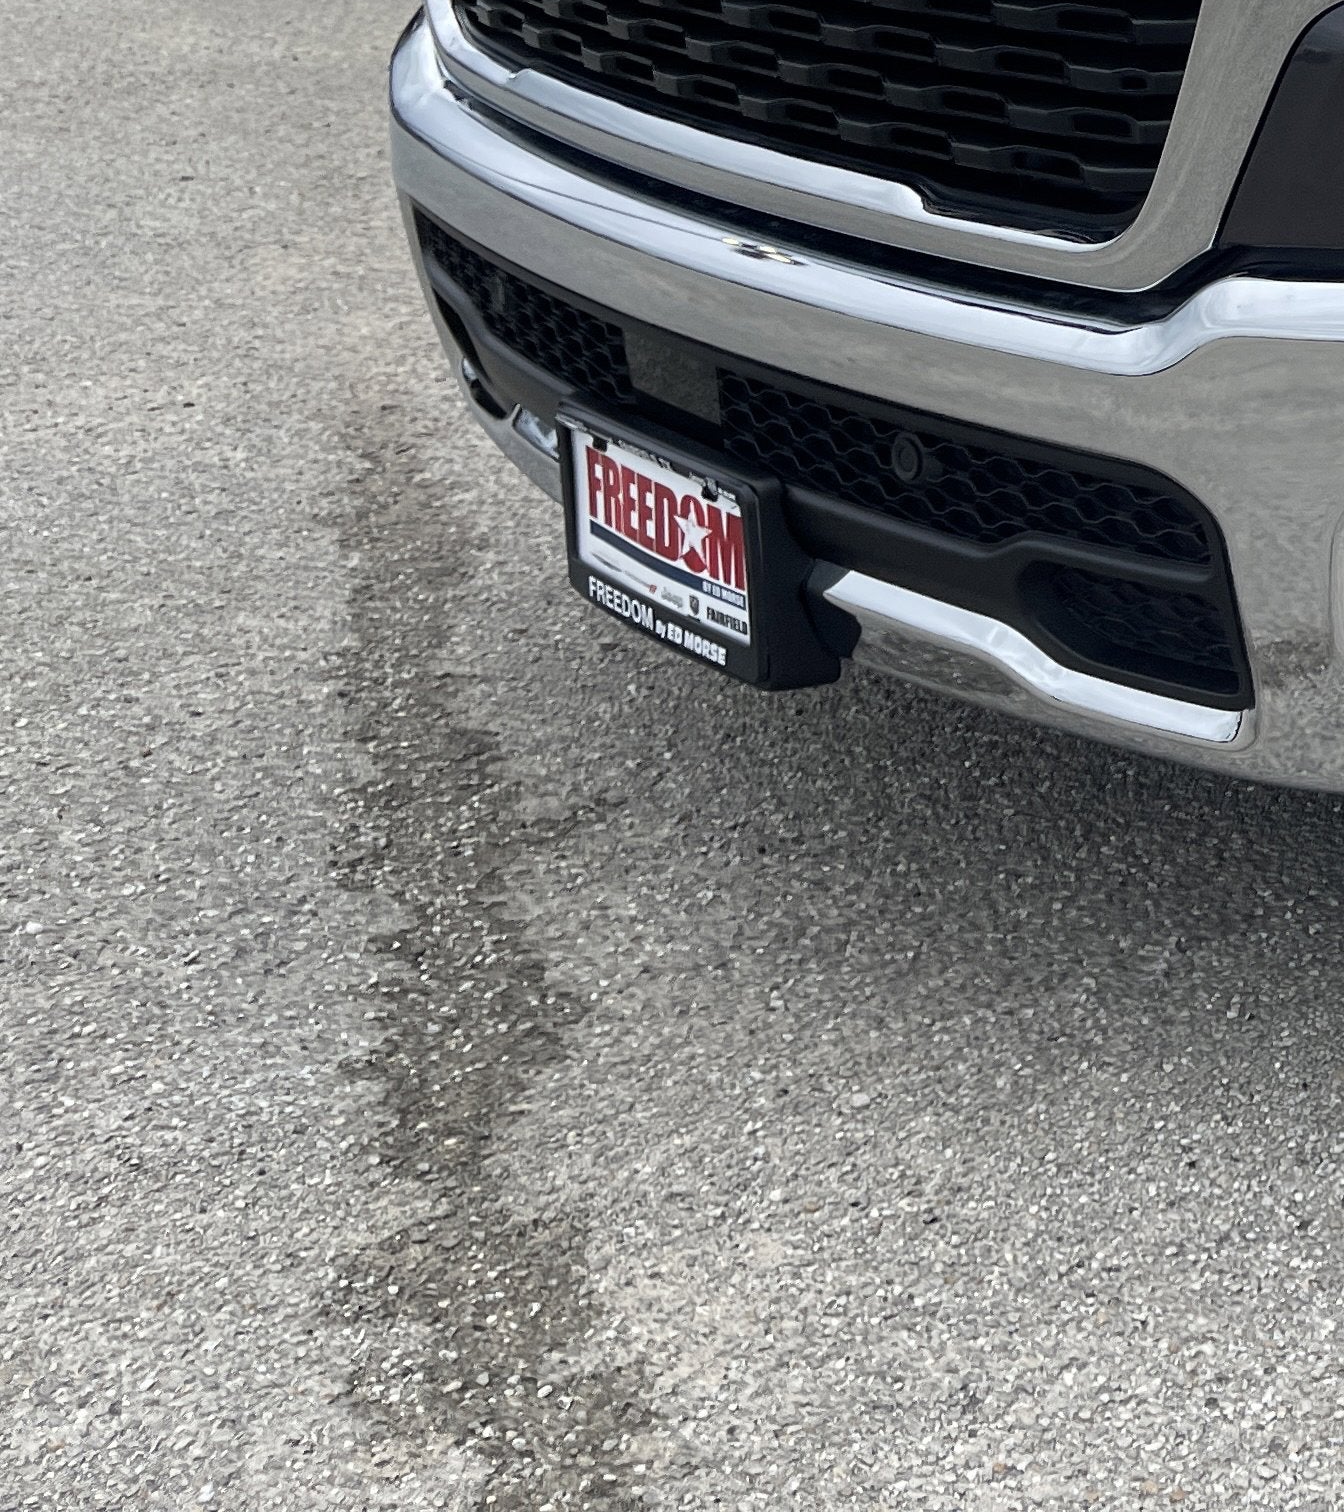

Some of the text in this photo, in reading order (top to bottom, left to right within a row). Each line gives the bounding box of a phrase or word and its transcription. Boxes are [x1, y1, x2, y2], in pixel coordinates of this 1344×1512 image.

[586, 445, 746, 591] FREEDOM
[588, 575, 654, 631] FREEDOM
[706, 606, 748, 635] FAIRFIELD
[667, 622, 683, 645] ED
[684, 629, 727, 666] MORSE
